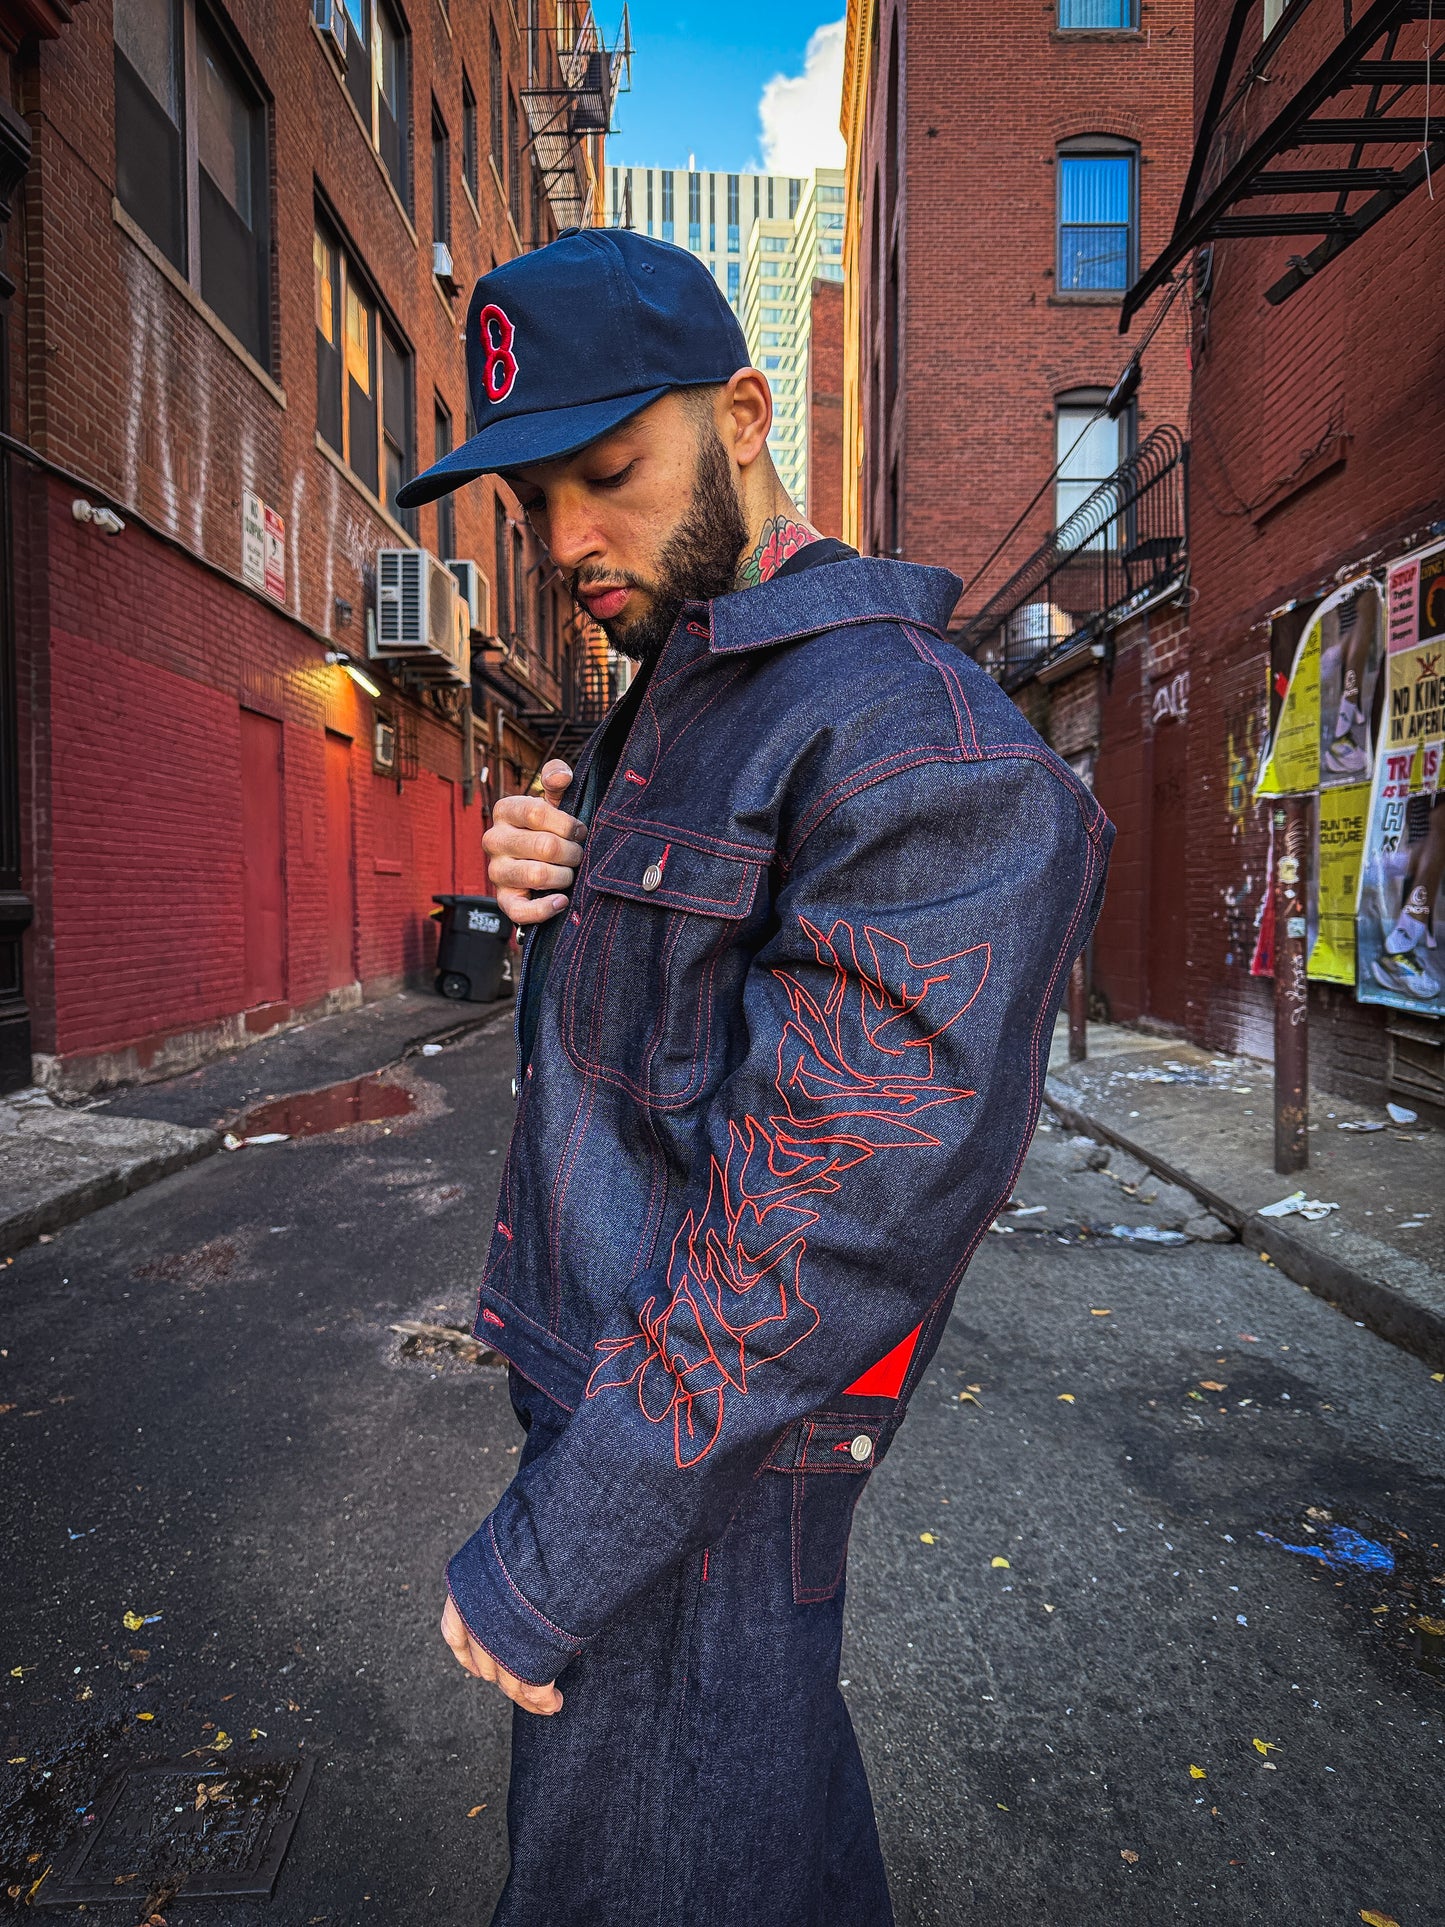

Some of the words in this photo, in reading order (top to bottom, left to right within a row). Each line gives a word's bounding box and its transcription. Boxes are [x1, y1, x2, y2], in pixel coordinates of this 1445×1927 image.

[1392, 686, 1411, 716] NO
[1391, 717, 1404, 741] IN
[1320, 819, 1340, 832] RUN
[1342, 815, 1363, 829] THE
[1320, 829, 1363, 845] CULTURE
